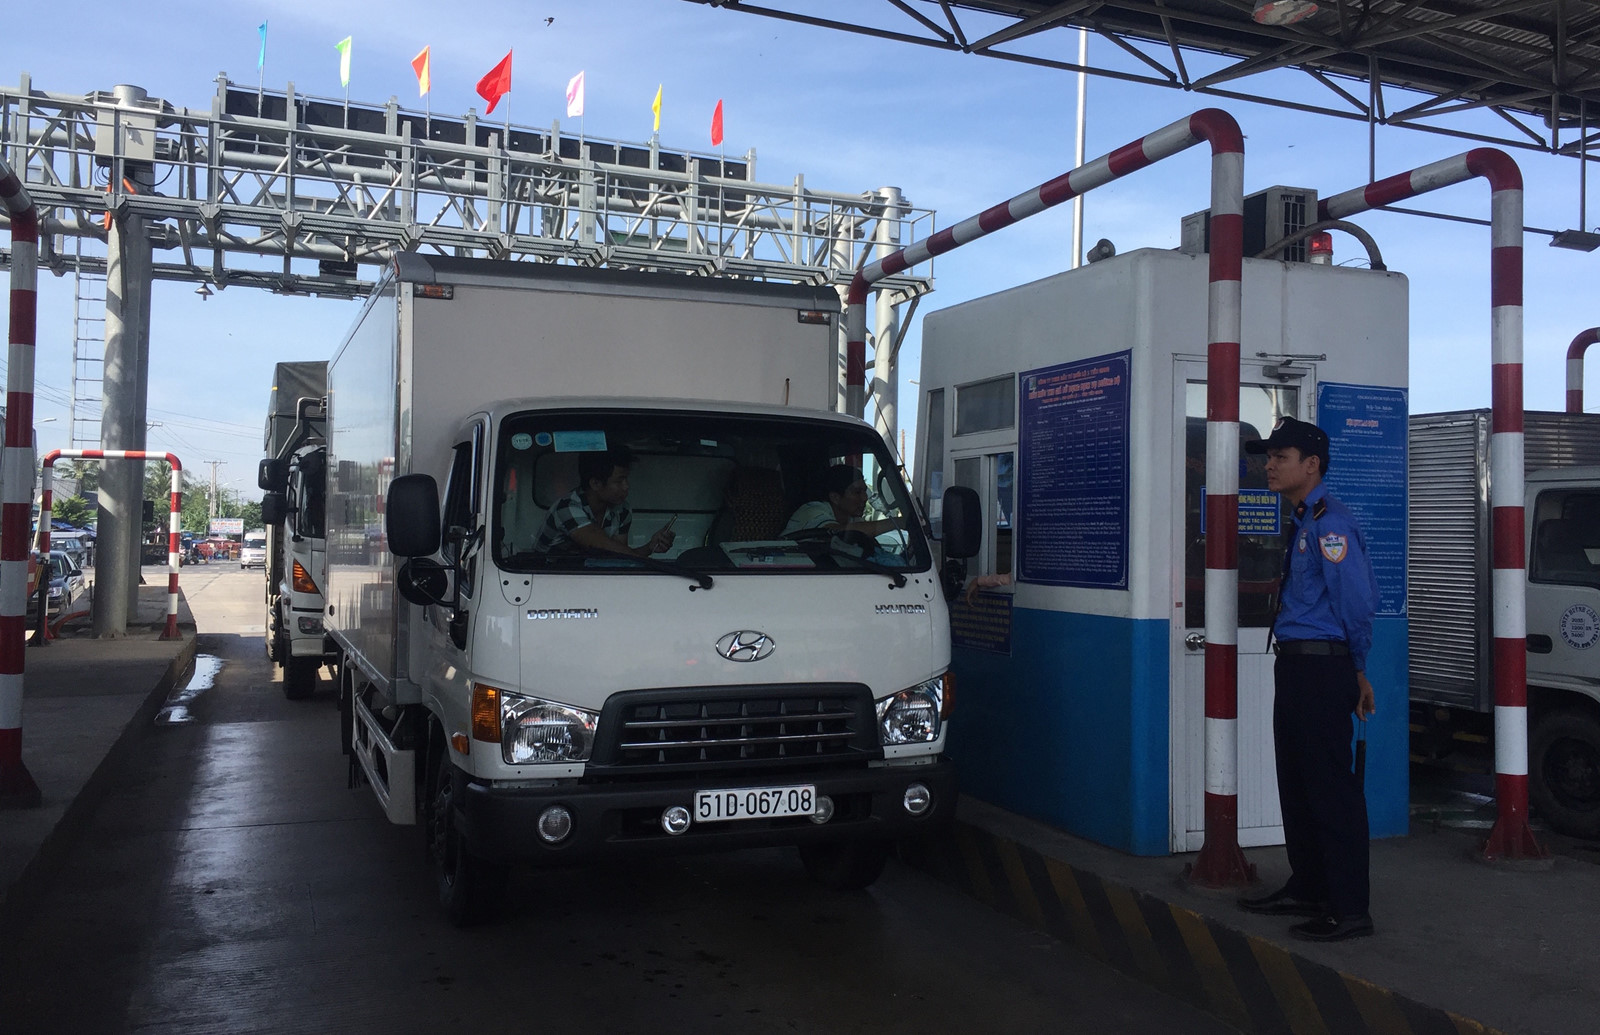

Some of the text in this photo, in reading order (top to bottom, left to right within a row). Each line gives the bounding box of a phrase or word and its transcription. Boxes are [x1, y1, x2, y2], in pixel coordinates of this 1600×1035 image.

[527, 608, 598, 620] DOTHANH
[875, 604, 926, 614] HYUNDAI
[699, 789, 812, 818] 51D-067.08
